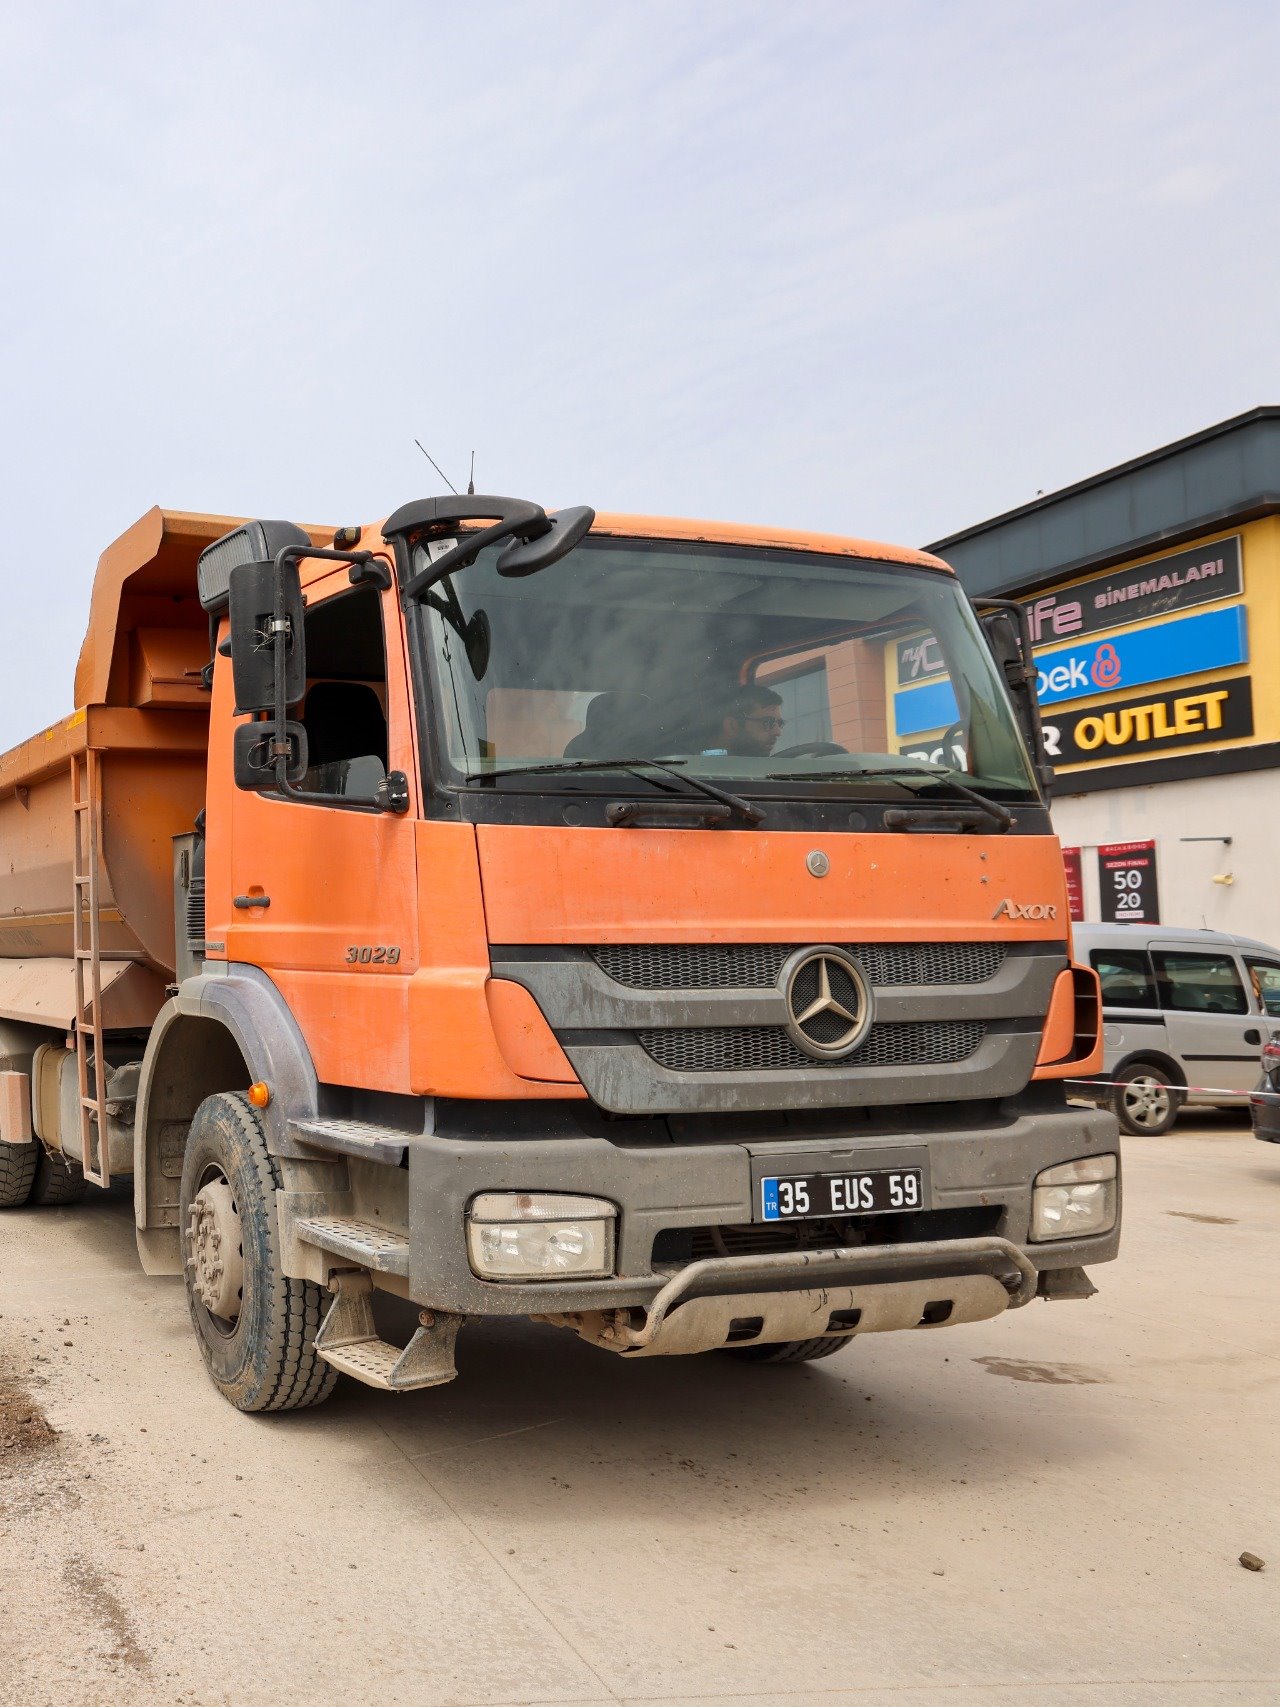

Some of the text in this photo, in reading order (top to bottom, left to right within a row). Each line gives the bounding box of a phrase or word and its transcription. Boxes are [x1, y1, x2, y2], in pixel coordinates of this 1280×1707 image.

[1074, 690, 1229, 750] OUTLET
[345, 946, 401, 965] 3029
[766, 1174, 918, 1214] TR 35 EUS 59
